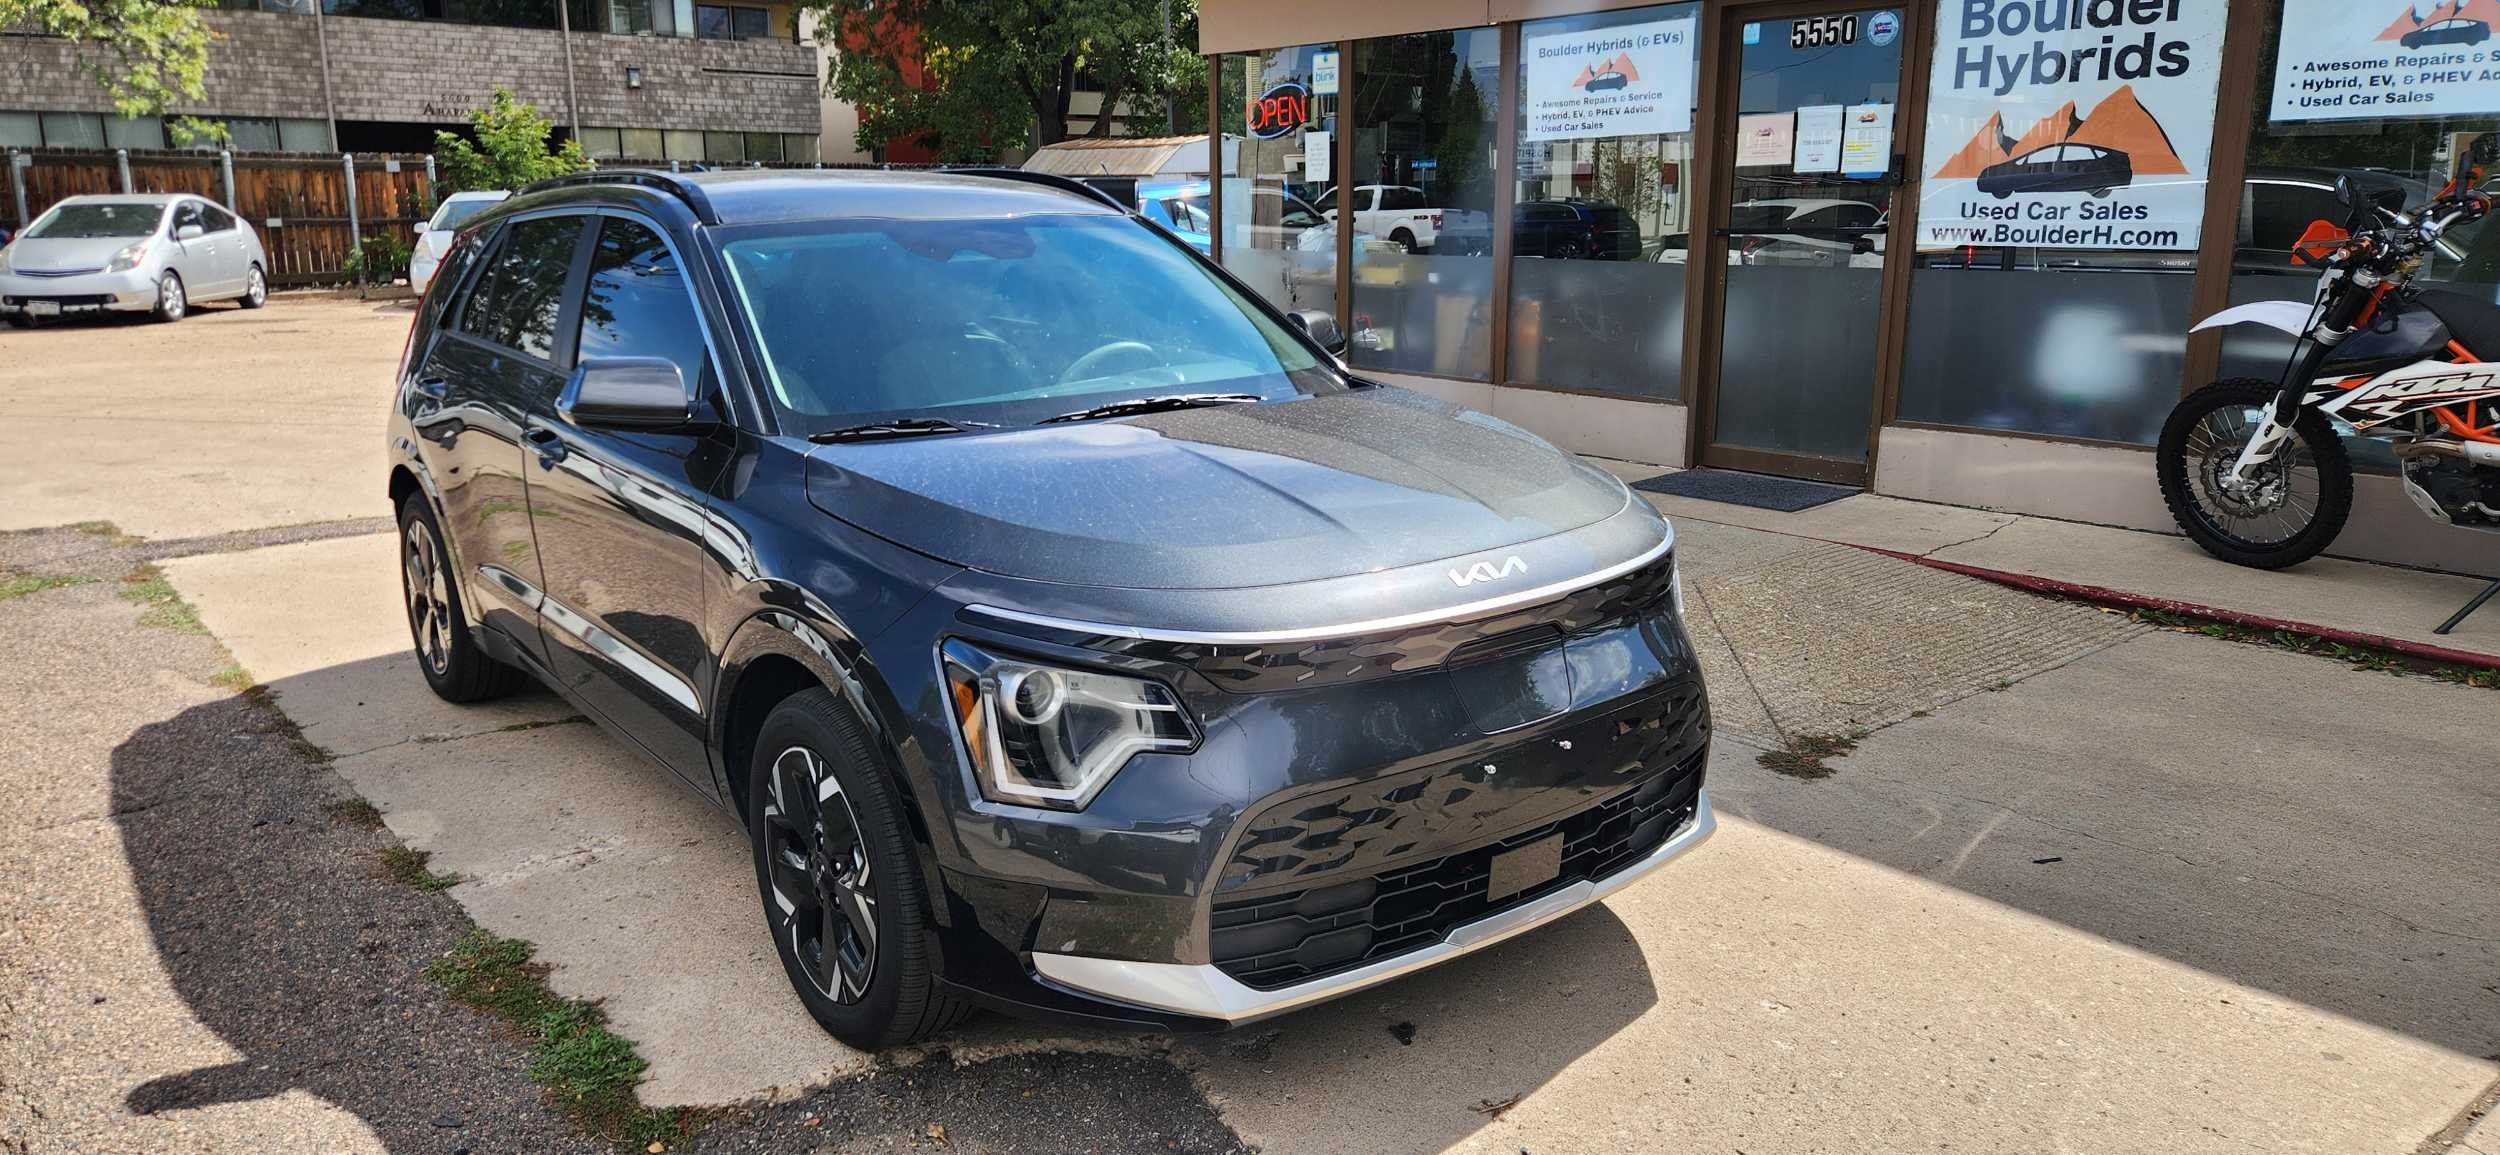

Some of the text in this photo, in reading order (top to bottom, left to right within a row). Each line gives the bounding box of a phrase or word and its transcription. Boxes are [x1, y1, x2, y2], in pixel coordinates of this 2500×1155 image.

[1960, 0, 2181, 39] Boulder
[1791, 15, 1859, 48] 5550
[1538, 44, 1583, 58] Boulder
[1587, 38, 1633, 54] Hybrids
[1653, 31, 1684, 46] EVs)
[1953, 32, 2190, 96] Hybrids
[2304, 60, 2389, 73] Awesome
[2395, 52, 2466, 68] Repairs
[2472, 52, 2485, 63] &
[2302, 76, 2363, 93] Hybrid,
[2369, 74, 2396, 88] EV,
[2403, 75, 2415, 85] &
[2419, 70, 2473, 84] PHEV
[1542, 99, 1581, 109] Awesome
[1583, 95, 1617, 106] Repairs
[1629, 91, 1663, 102] Service
[1596, 107, 1621, 116] PHEV
[1623, 104, 1654, 114] Advice
[2299, 91, 2435, 108] Used Car Sales
[1246, 95, 1306, 130] OPEN
[1541, 119, 1604, 133] Used Car Sales
[1961, 201, 2149, 220] Used Car Sales
[1931, 224, 2179, 246] www.BoulderH.com
[2166, 259, 2192, 267] HUSKY
[1448, 555, 1528, 587] KIA
